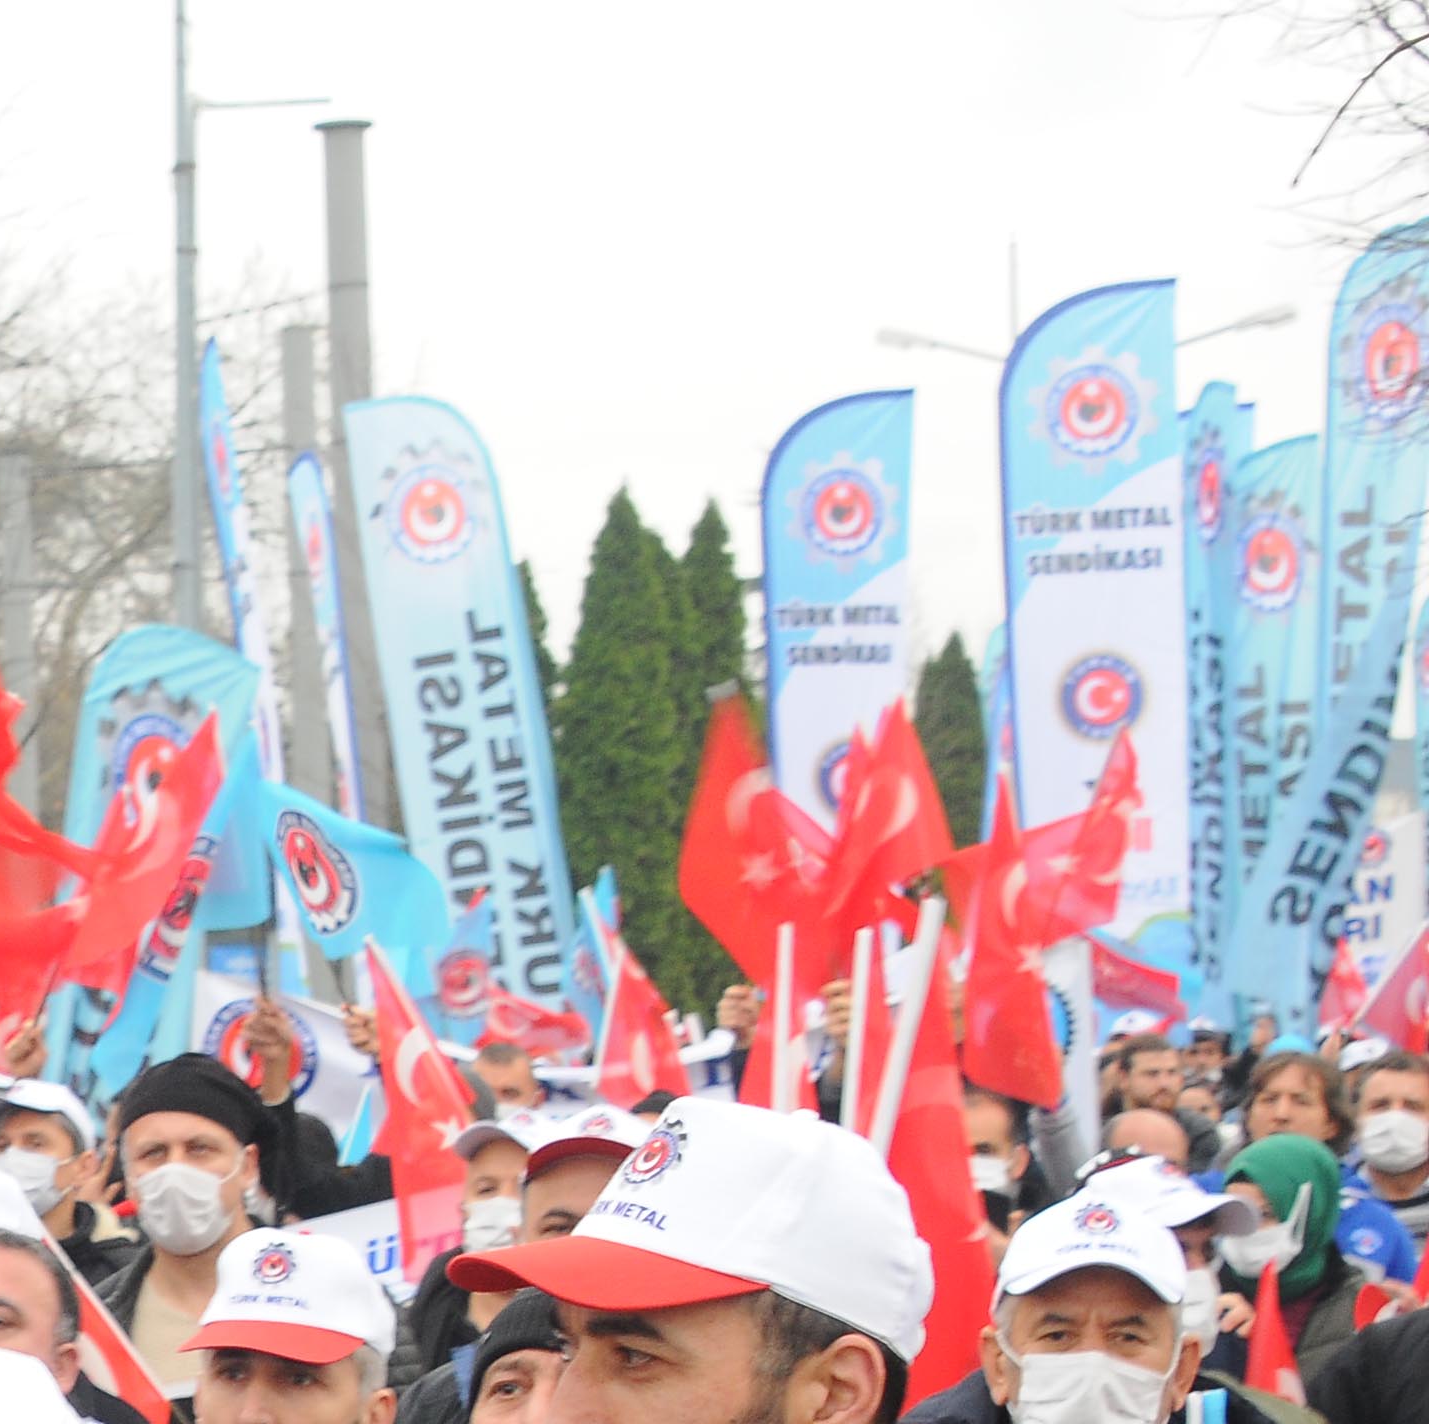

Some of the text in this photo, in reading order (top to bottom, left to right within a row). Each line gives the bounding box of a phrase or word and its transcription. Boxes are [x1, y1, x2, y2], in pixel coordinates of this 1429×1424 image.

[1091, 507, 1173, 531] METAL
[1028, 543, 1163, 577] SENDİKASI
[613, 1200, 668, 1231] METAL
